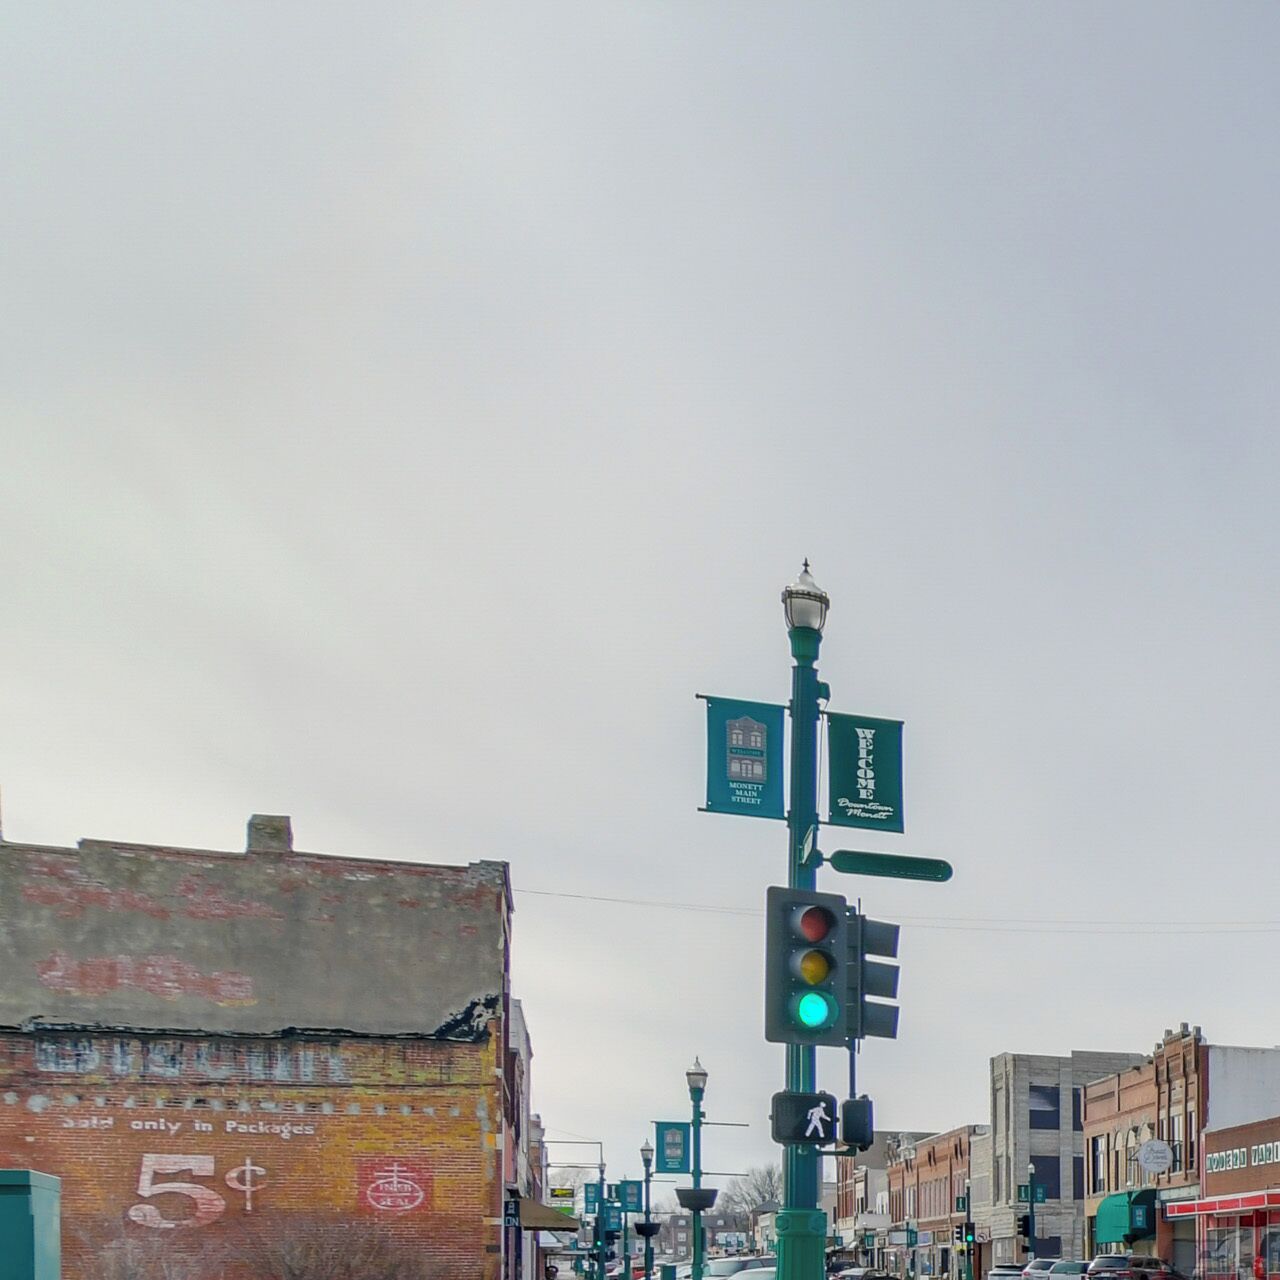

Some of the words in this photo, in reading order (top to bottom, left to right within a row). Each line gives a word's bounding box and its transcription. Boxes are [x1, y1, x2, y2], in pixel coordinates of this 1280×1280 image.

[855, 727, 876, 800] WELCOME
[729, 781, 763, 791] MONETT
[735, 789, 757, 797] MAIN
[731, 795, 761, 805] STREET
[837, 797, 894, 812] Downtown
[845, 808, 893, 820] Monett
[131, 1117, 182, 1134] only
[194, 1118, 213, 1133] in
[226, 1119, 315, 1140] Packages
